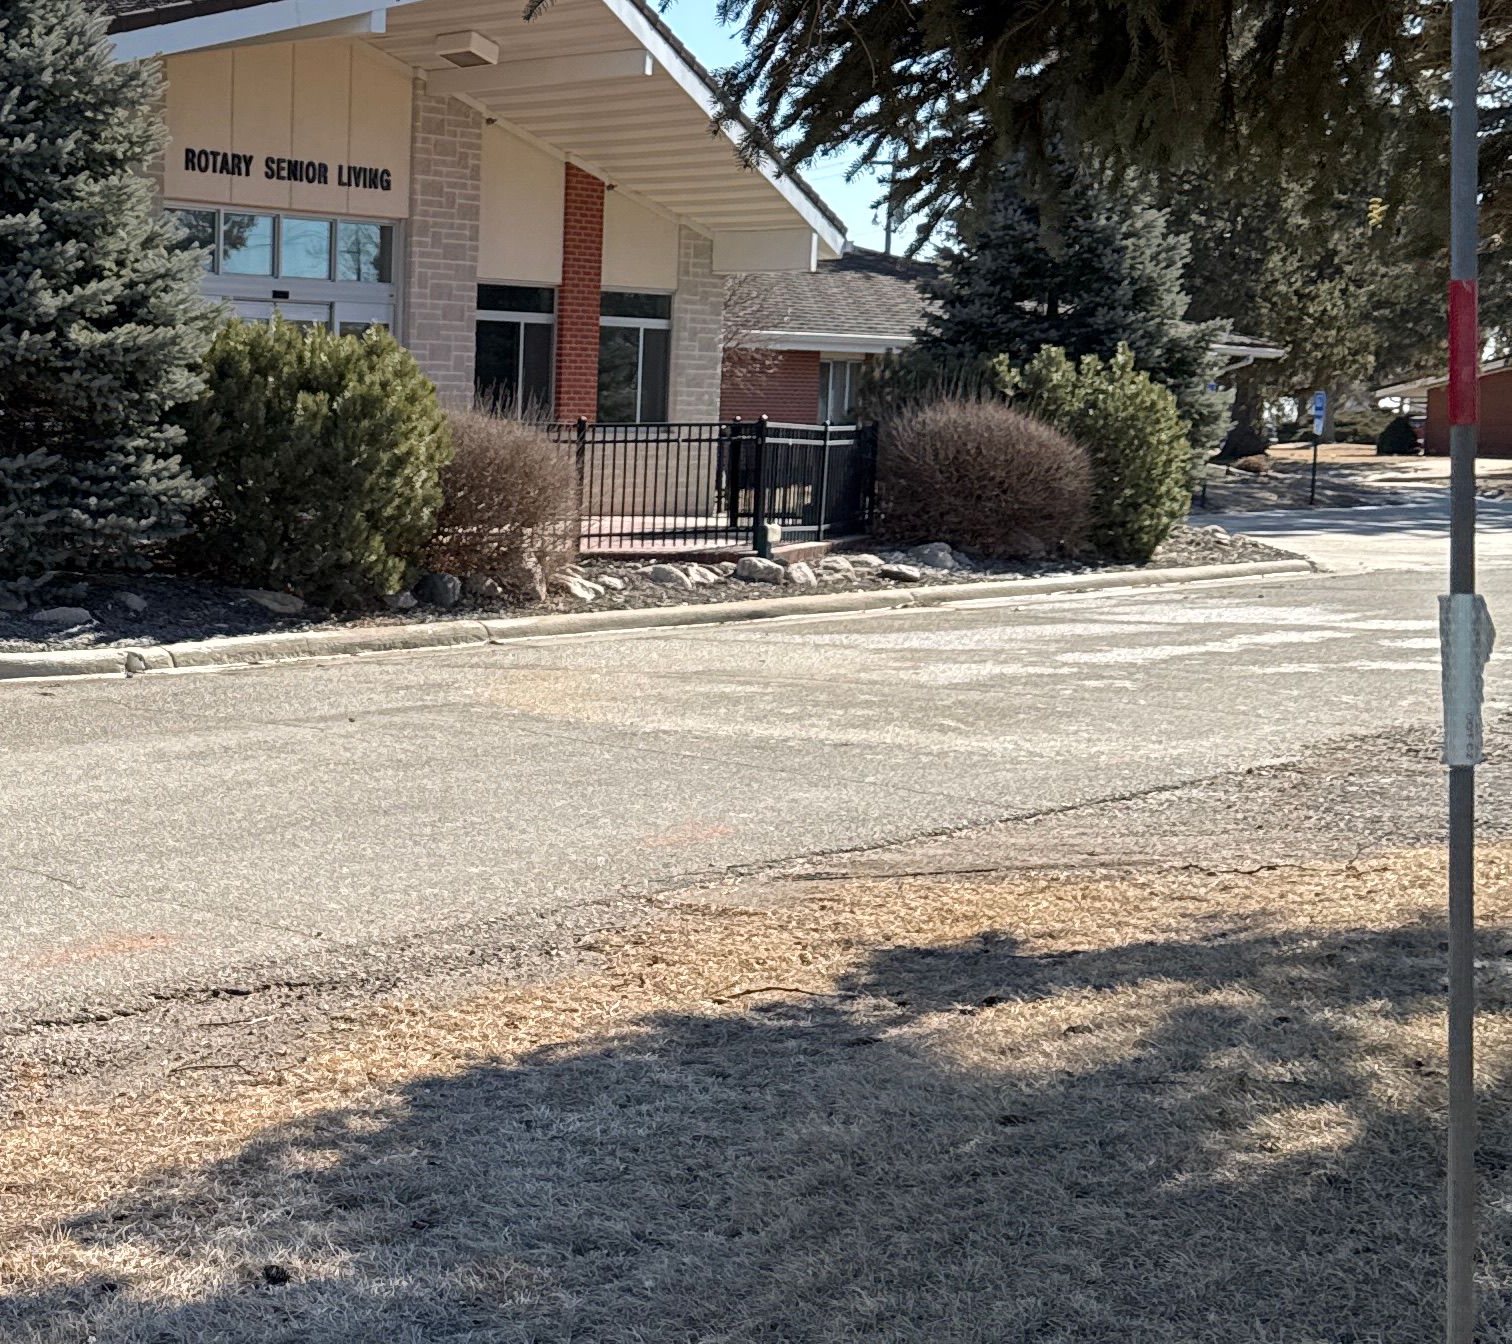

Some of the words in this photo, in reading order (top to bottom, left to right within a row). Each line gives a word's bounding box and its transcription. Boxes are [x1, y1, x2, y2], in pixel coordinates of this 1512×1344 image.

[184, 148, 254, 177] ROTARY
[264, 156, 329, 185] SENIOR
[337, 164, 392, 191] LIVING
